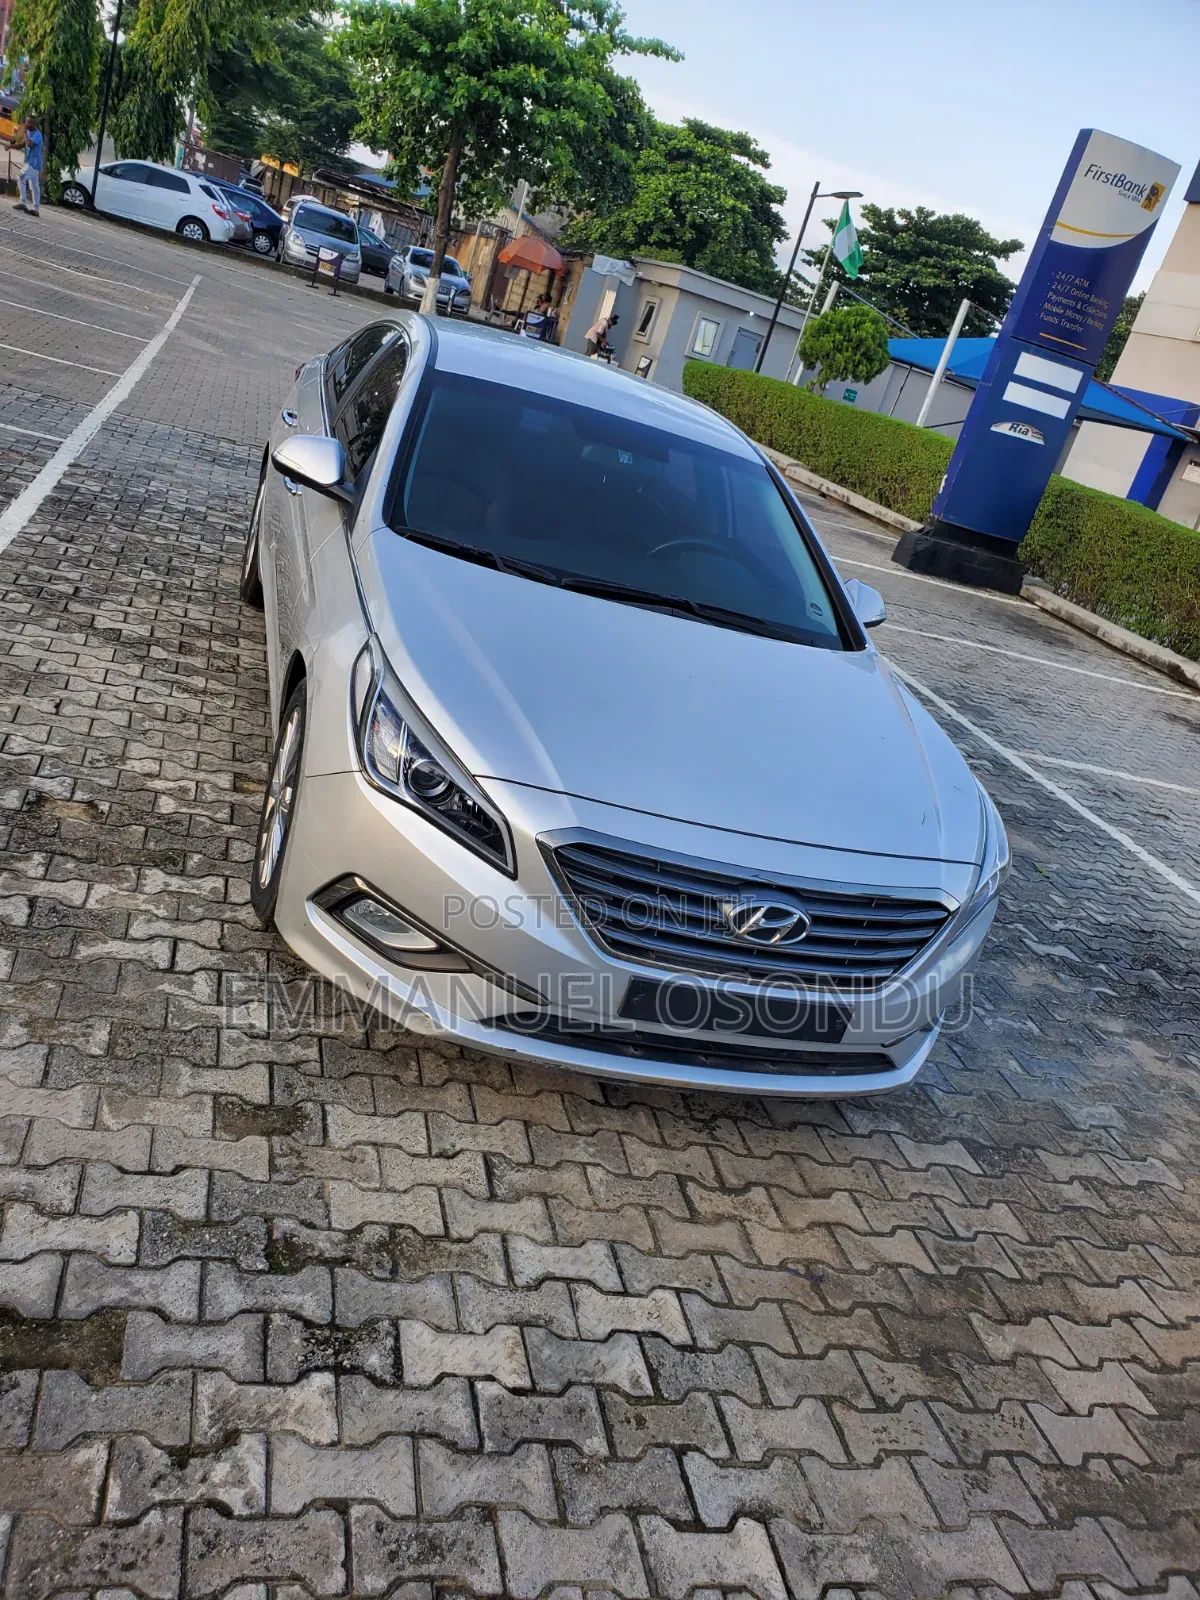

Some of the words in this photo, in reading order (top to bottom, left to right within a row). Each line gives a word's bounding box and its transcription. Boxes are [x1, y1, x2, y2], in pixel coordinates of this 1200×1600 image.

[1084, 163, 1148, 198] FirstBank
[1117, 189, 1131, 200] Since
[1131, 195, 1141, 204] 1894
[1056, 271, 1075, 282] 24/7
[1074, 277, 1090, 288] ATM
[1047, 291, 1076, 307] Payments
[1076, 301, 1082, 310] &
[1082, 304, 1108, 319] Collections
[1052, 281, 1070, 292] 24/7
[1070, 287, 1090, 300] Online
[1089, 294, 1109, 310] Banking
[1039, 312, 1059, 325] Funds
[1060, 318, 1084, 333] Transfer
[1043, 302, 1065, 315] Mobile
[1064, 309, 1084, 323] Money
[1086, 316, 1105, 331] Banking
[1008, 422, 1030, 436] Ria
